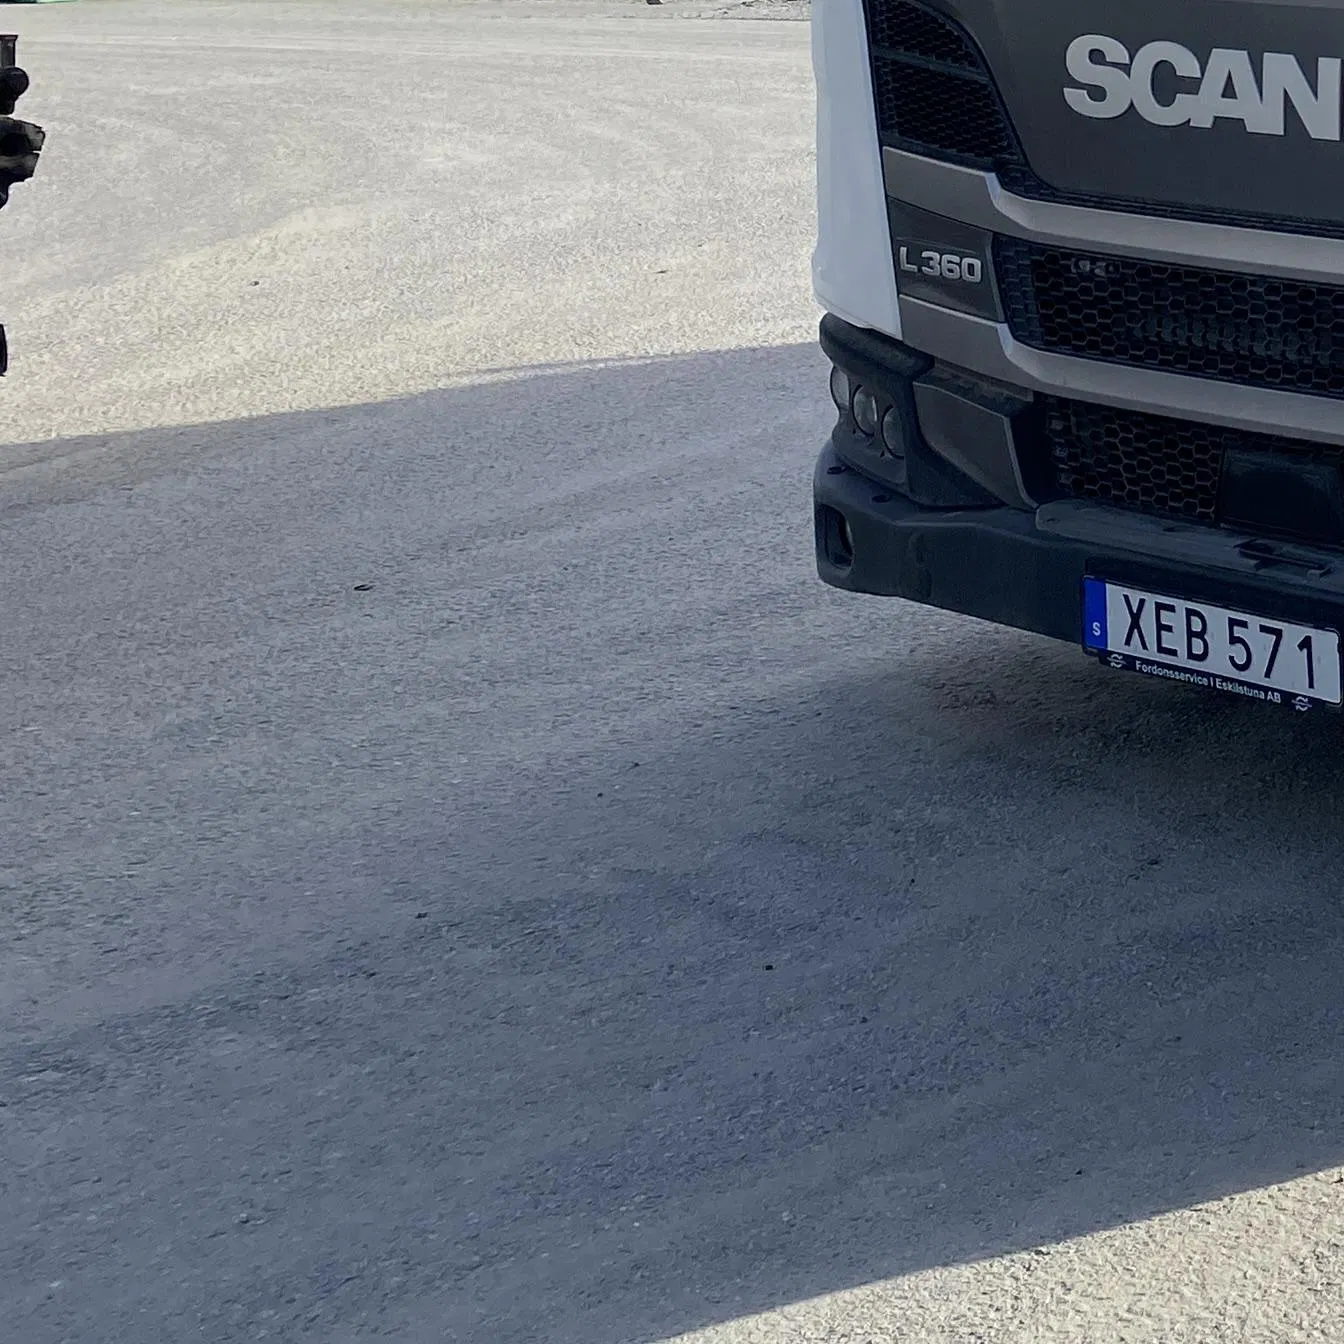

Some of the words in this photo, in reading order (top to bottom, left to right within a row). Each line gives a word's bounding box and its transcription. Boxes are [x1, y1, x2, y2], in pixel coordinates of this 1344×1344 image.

[899, 246, 918, 272] L
[921, 250, 982, 283] 360
[1092, 622, 1102, 637] S
[1122, 593, 1210, 663] XEB
[1227, 616, 1316, 700] 571
[1135, 660, 1209, 687] Fordonsservice
[1215, 678, 1265, 700] Eskilstuna
[1266, 690, 1282, 704] AB
